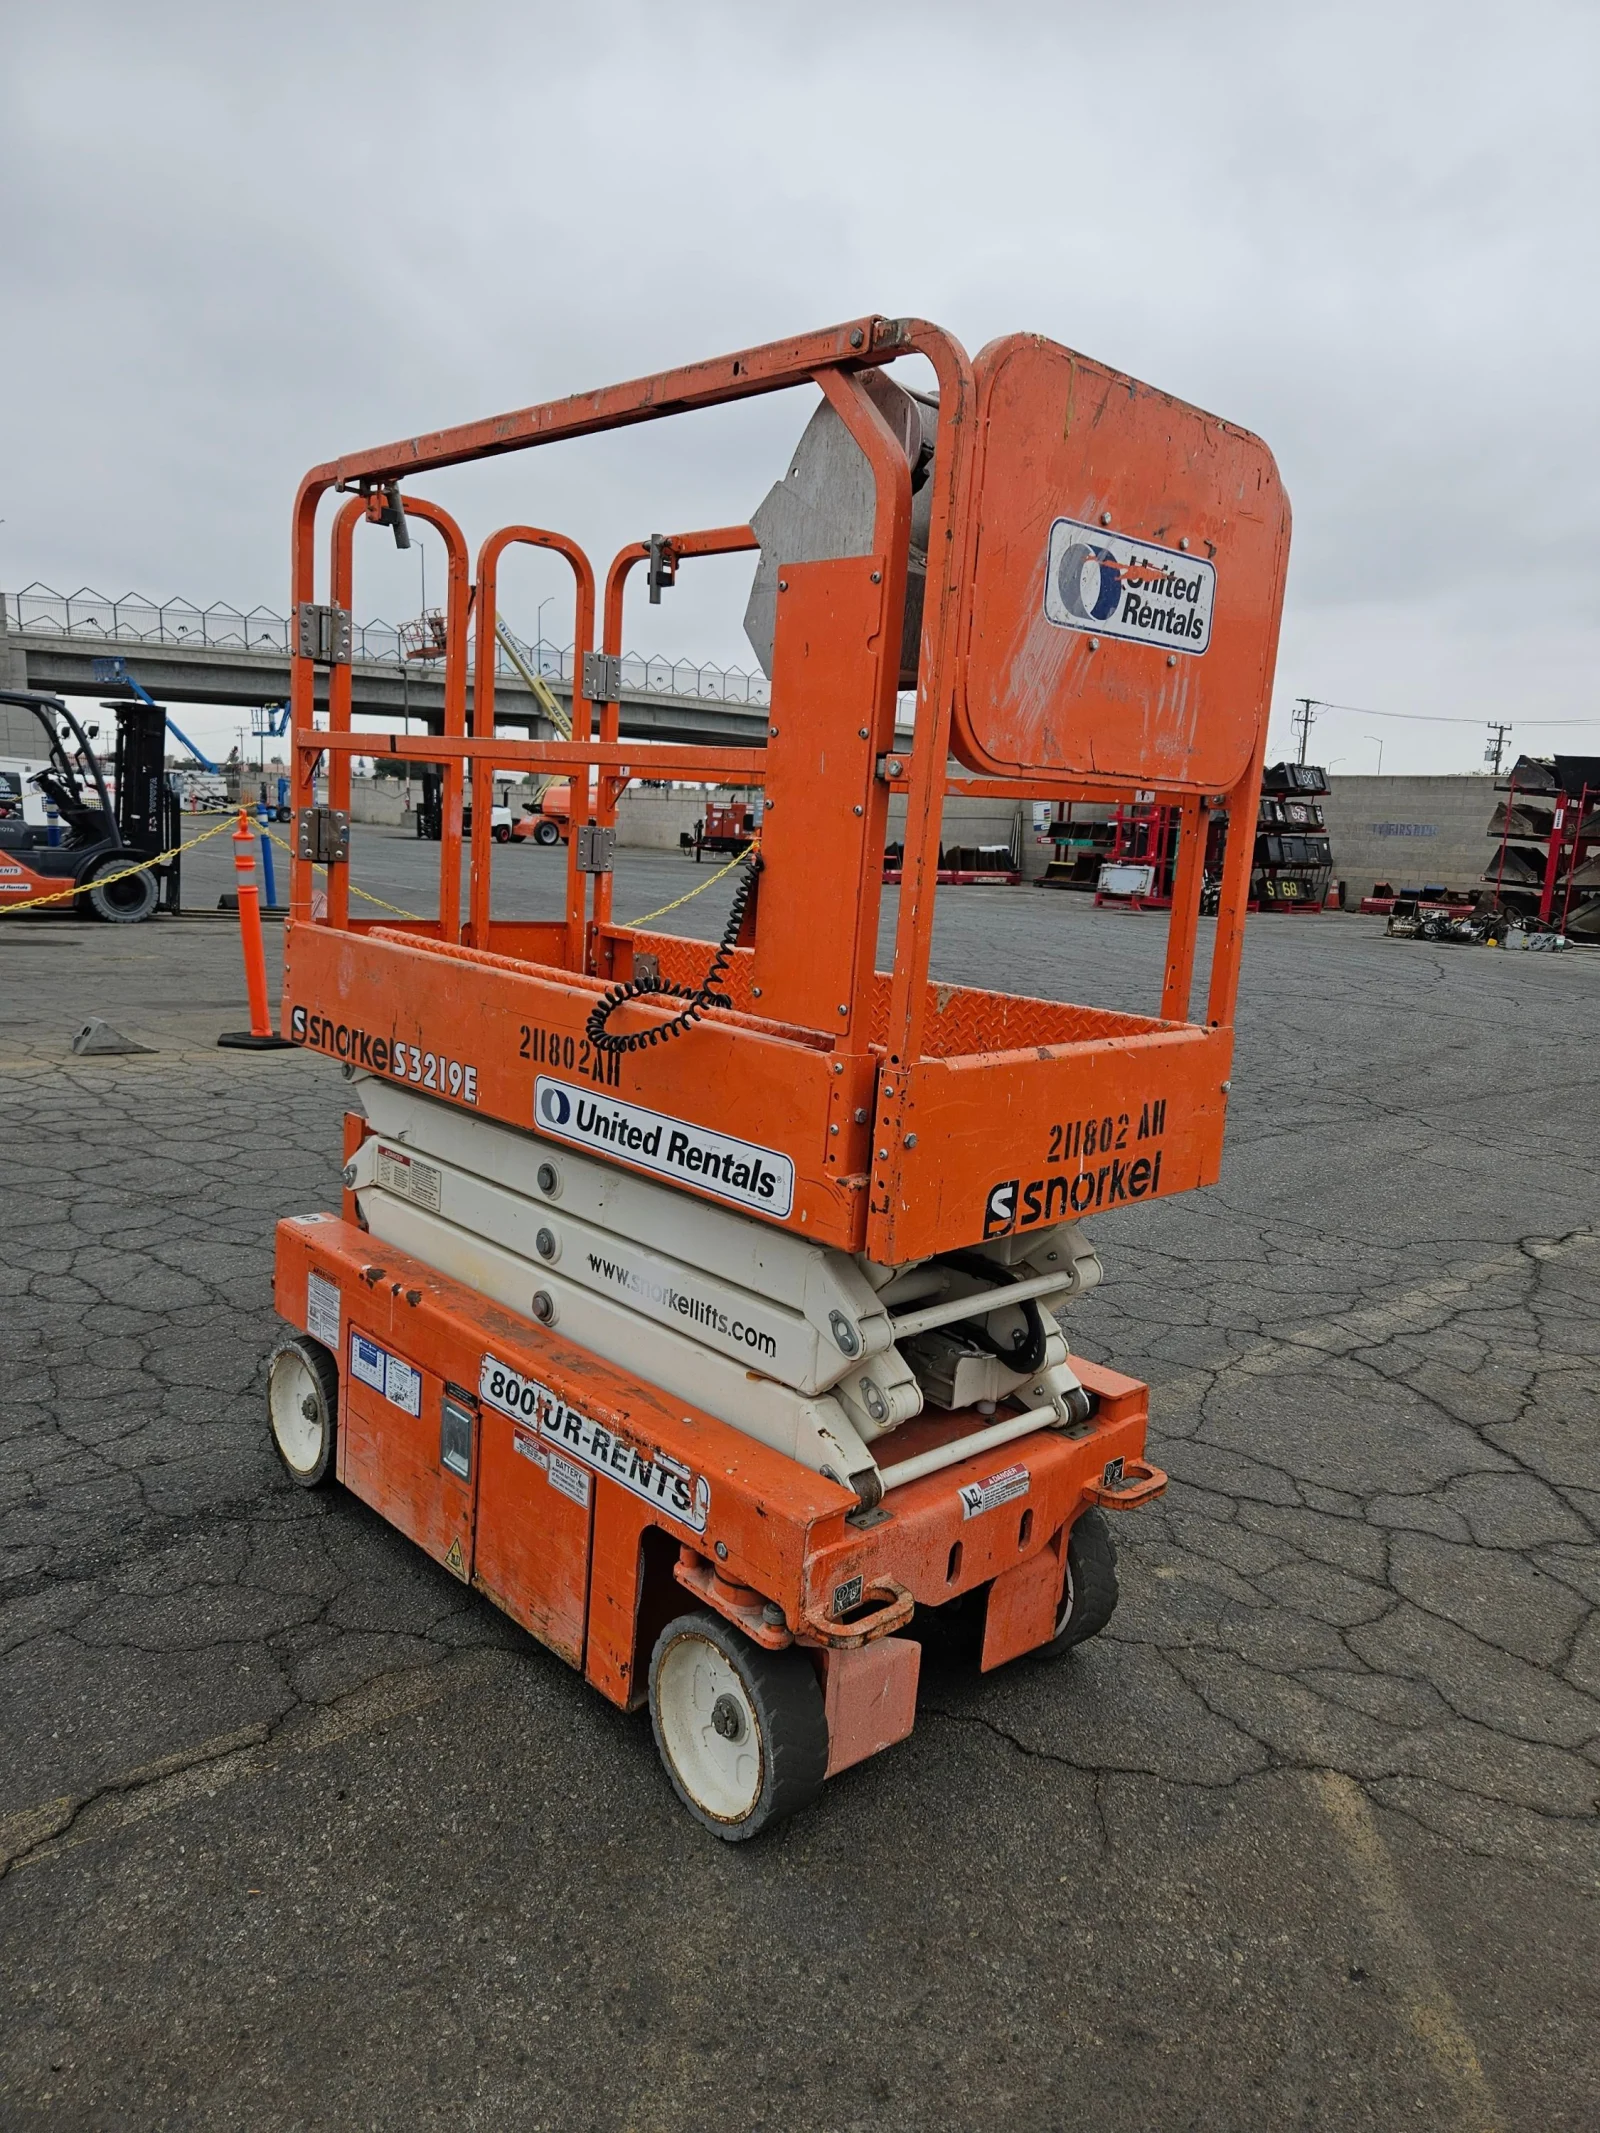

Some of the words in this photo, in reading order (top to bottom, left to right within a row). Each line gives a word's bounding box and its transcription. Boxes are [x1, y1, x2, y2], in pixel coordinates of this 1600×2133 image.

[1121, 592, 1204, 640] Rentals
[393, 1042, 478, 1105] S3219E
[576, 1099, 663, 1157] United
[666, 1130, 777, 1198] Rentals
[1020, 1151, 1162, 1226] snorkel
[589, 1252, 777, 1358] www.snorkellifts.com
[555, 1458, 583, 1481] BATTERY
[991, 1466, 1018, 1483] DANGER
